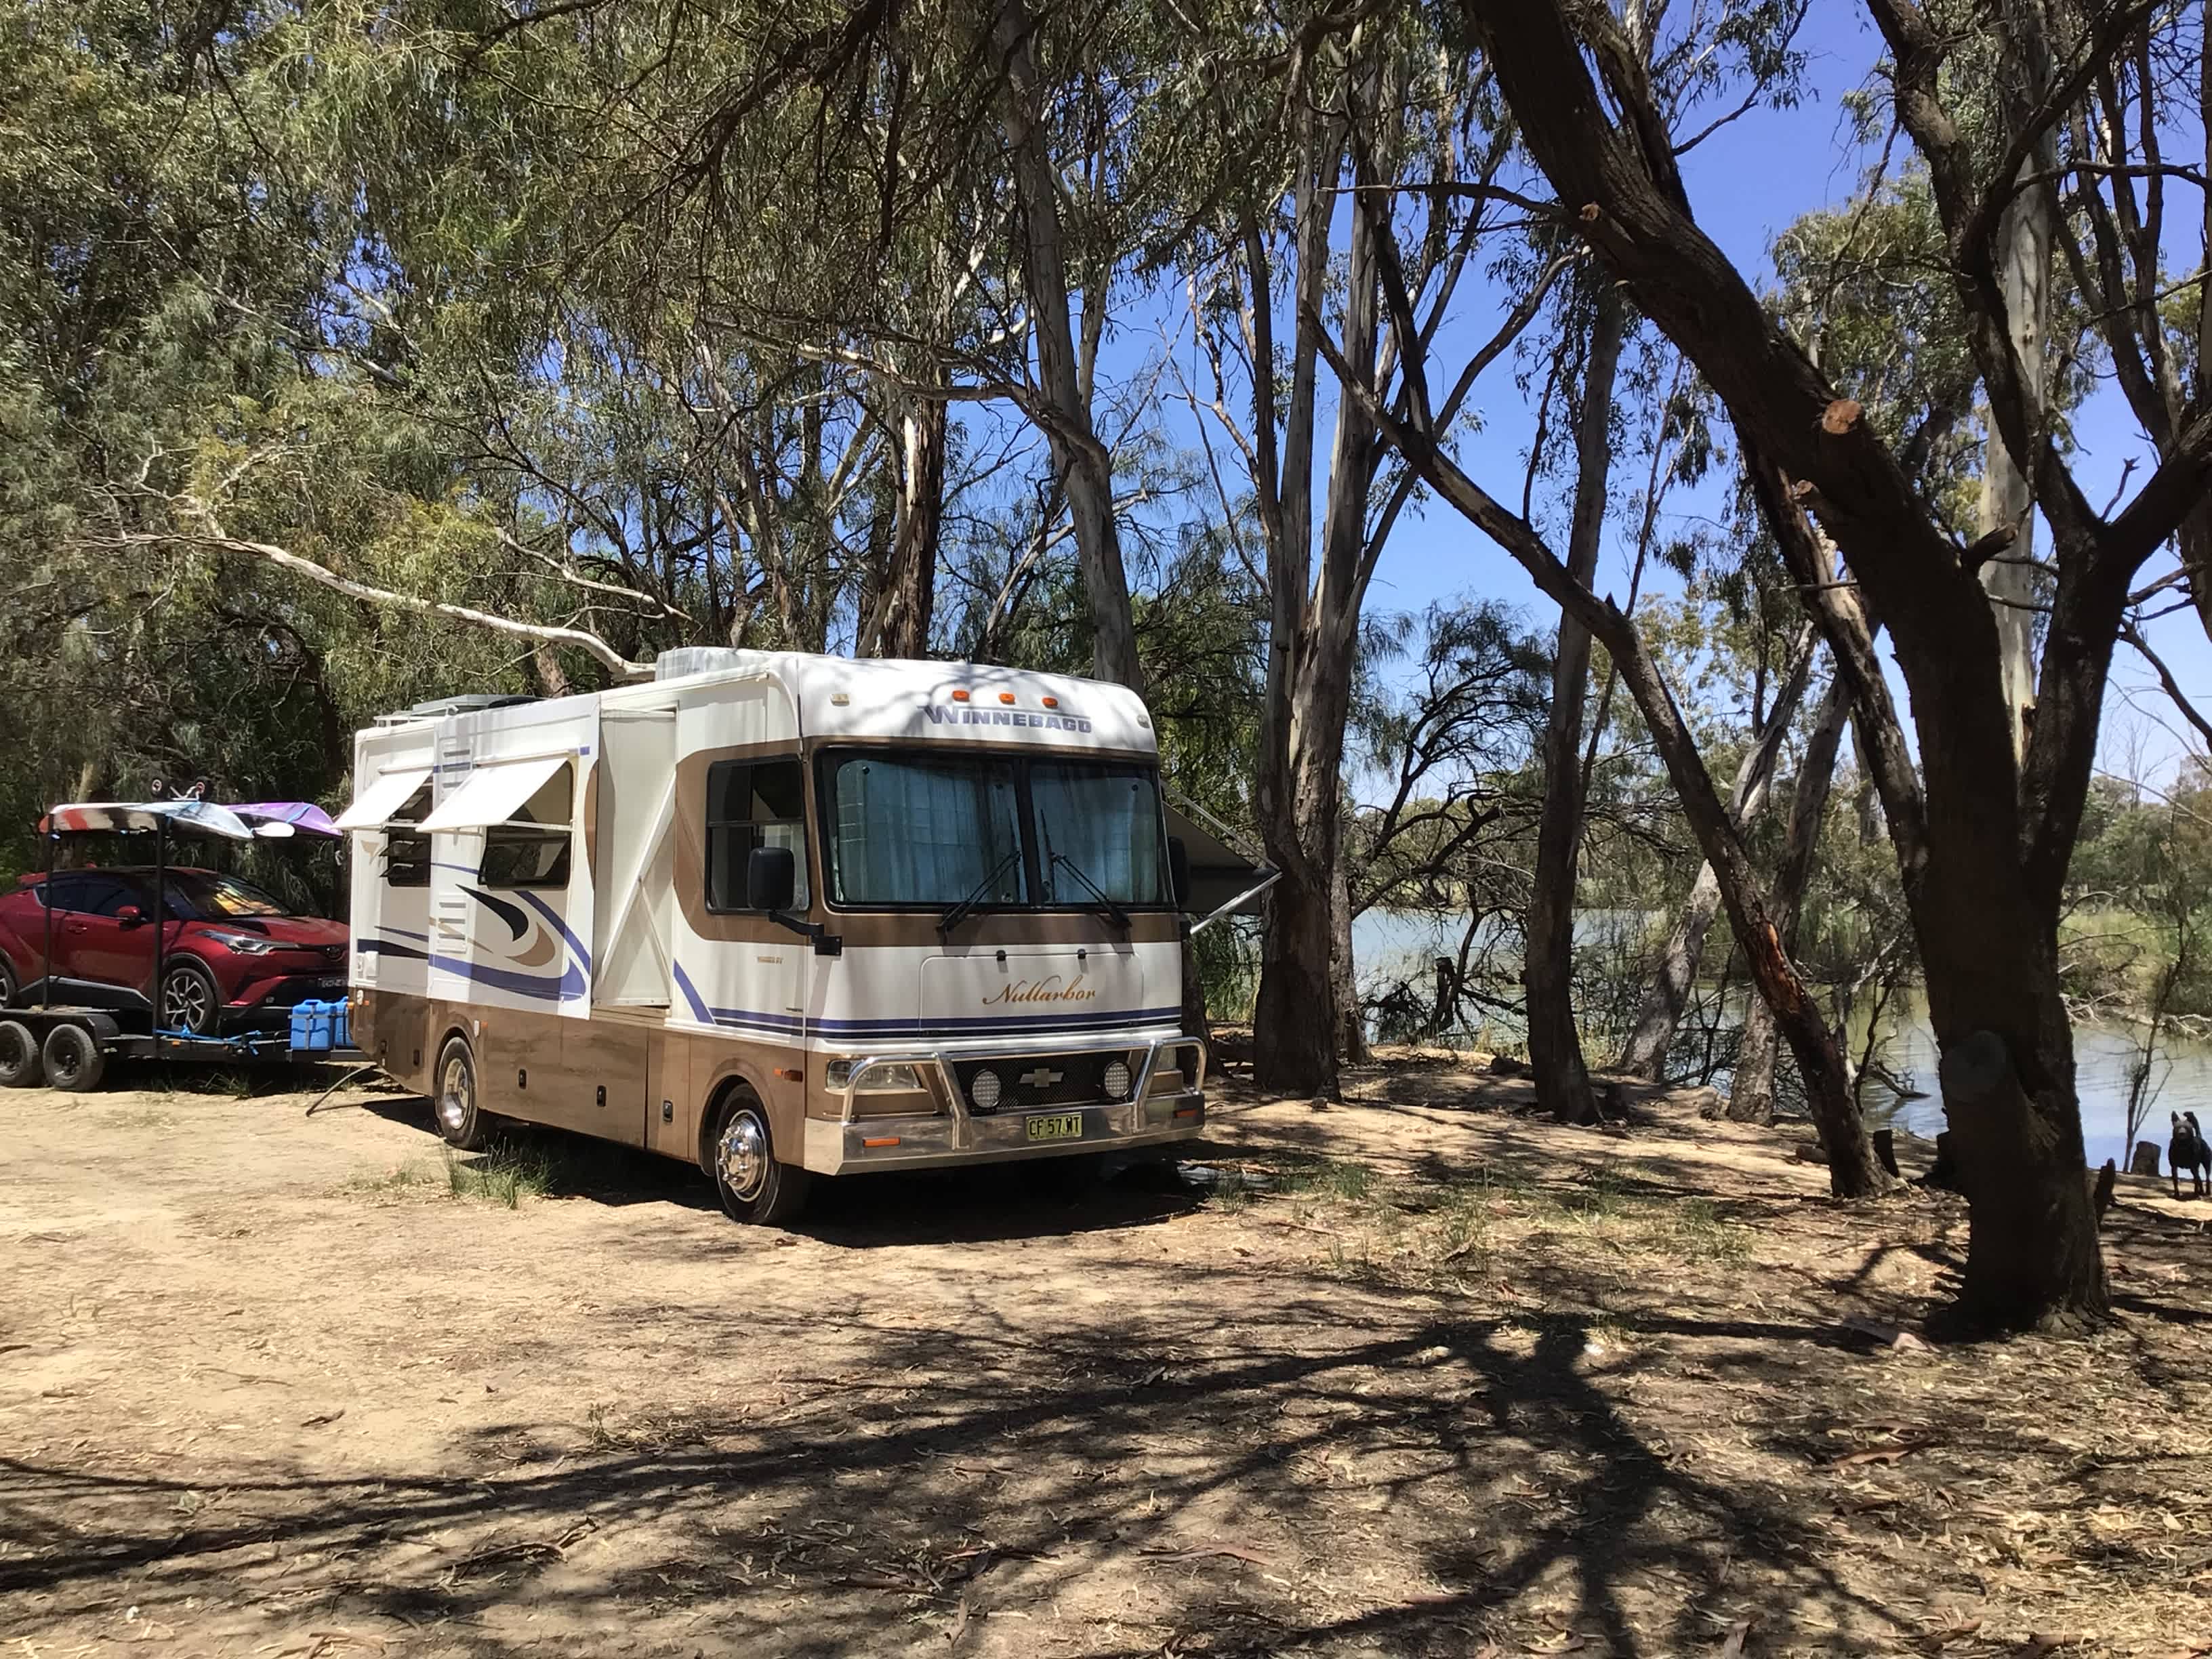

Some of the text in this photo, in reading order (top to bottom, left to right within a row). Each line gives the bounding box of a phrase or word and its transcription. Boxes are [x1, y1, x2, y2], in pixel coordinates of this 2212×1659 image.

[919, 705, 1092, 733] WINNEBAGO
[982, 975, 1096, 1005] Nullarbor
[1029, 1120, 1044, 1135] CF
[1048, 1118, 1062, 1134] 57
